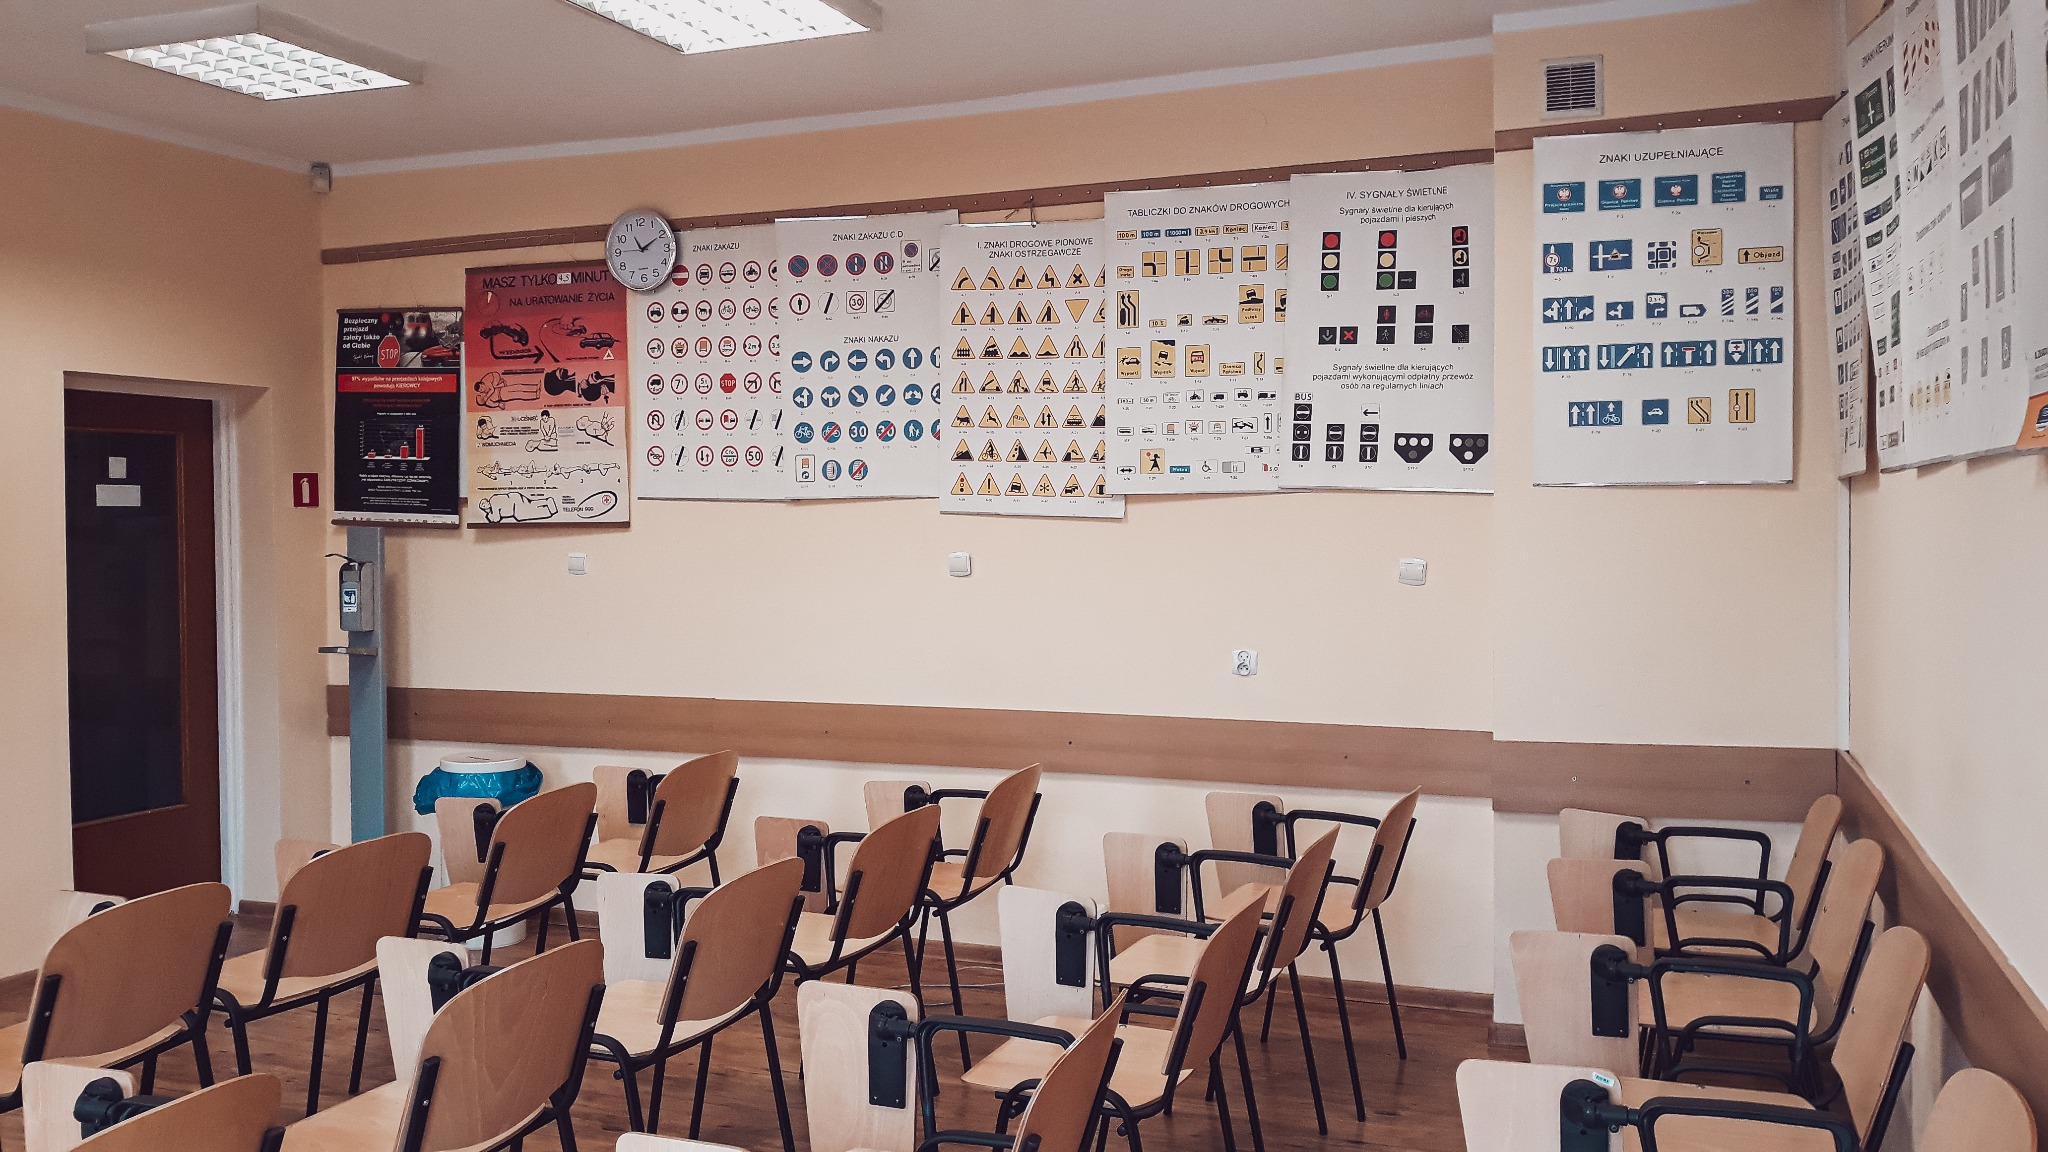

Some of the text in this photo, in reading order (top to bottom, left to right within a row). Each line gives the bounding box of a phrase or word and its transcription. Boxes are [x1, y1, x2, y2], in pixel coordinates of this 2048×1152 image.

[1599, 146, 1724, 164] ZNAKI UZUPEŁNIAJĄCE
[1346, 186, 1447, 200] IV. SYGNAŁY ŚWIETLNE
[1128, 199, 1290, 218] TABLICZKI DO ZNAKÓW DROGOWYCH
[636, 218, 646, 226] 12
[626, 224, 632, 232] 11
[659, 230, 666, 238] 2
[832, 234, 856, 242] ZNAKI
[858, 232, 888, 241] ZAKAZU
[617, 234, 626, 244] 10
[1010, 240, 1053, 248] DROGOWE
[1055, 238, 1094, 246] PIONOWE
[664, 244, 670, 252] 3
[692, 242, 740, 252] ZNAKI ZAKAZU
[615, 248, 621, 257] 9
[1014, 248, 1082, 257] OSTRZEGAWCZE
[620, 262, 626, 270] 8
[661, 258, 667, 266] 4
[629, 271, 635, 280] 7
[653, 269, 659, 277] 5
[482, 276, 516, 289] MASZ
[521, 273, 558, 286] TYLKO
[571, 270, 614, 283] MINUT
[641, 274, 648, 282] 6
[510, 298, 522, 307] NA
[526, 292, 583, 306] URATOWANIE
[844, 335, 899, 344] ZNAKI NAKAZU
[380, 348, 398, 360] STOP
[1332, 364, 1362, 372] Sygnały
[1411, 363, 1454, 372] kierujących
[1352, 373, 1405, 381] wykonującymi
[1442, 373, 1474, 381] przewóz
[1295, 393, 1312, 401] BUS
[851, 426, 867, 437] 30
[748, 451, 761, 461] 50
